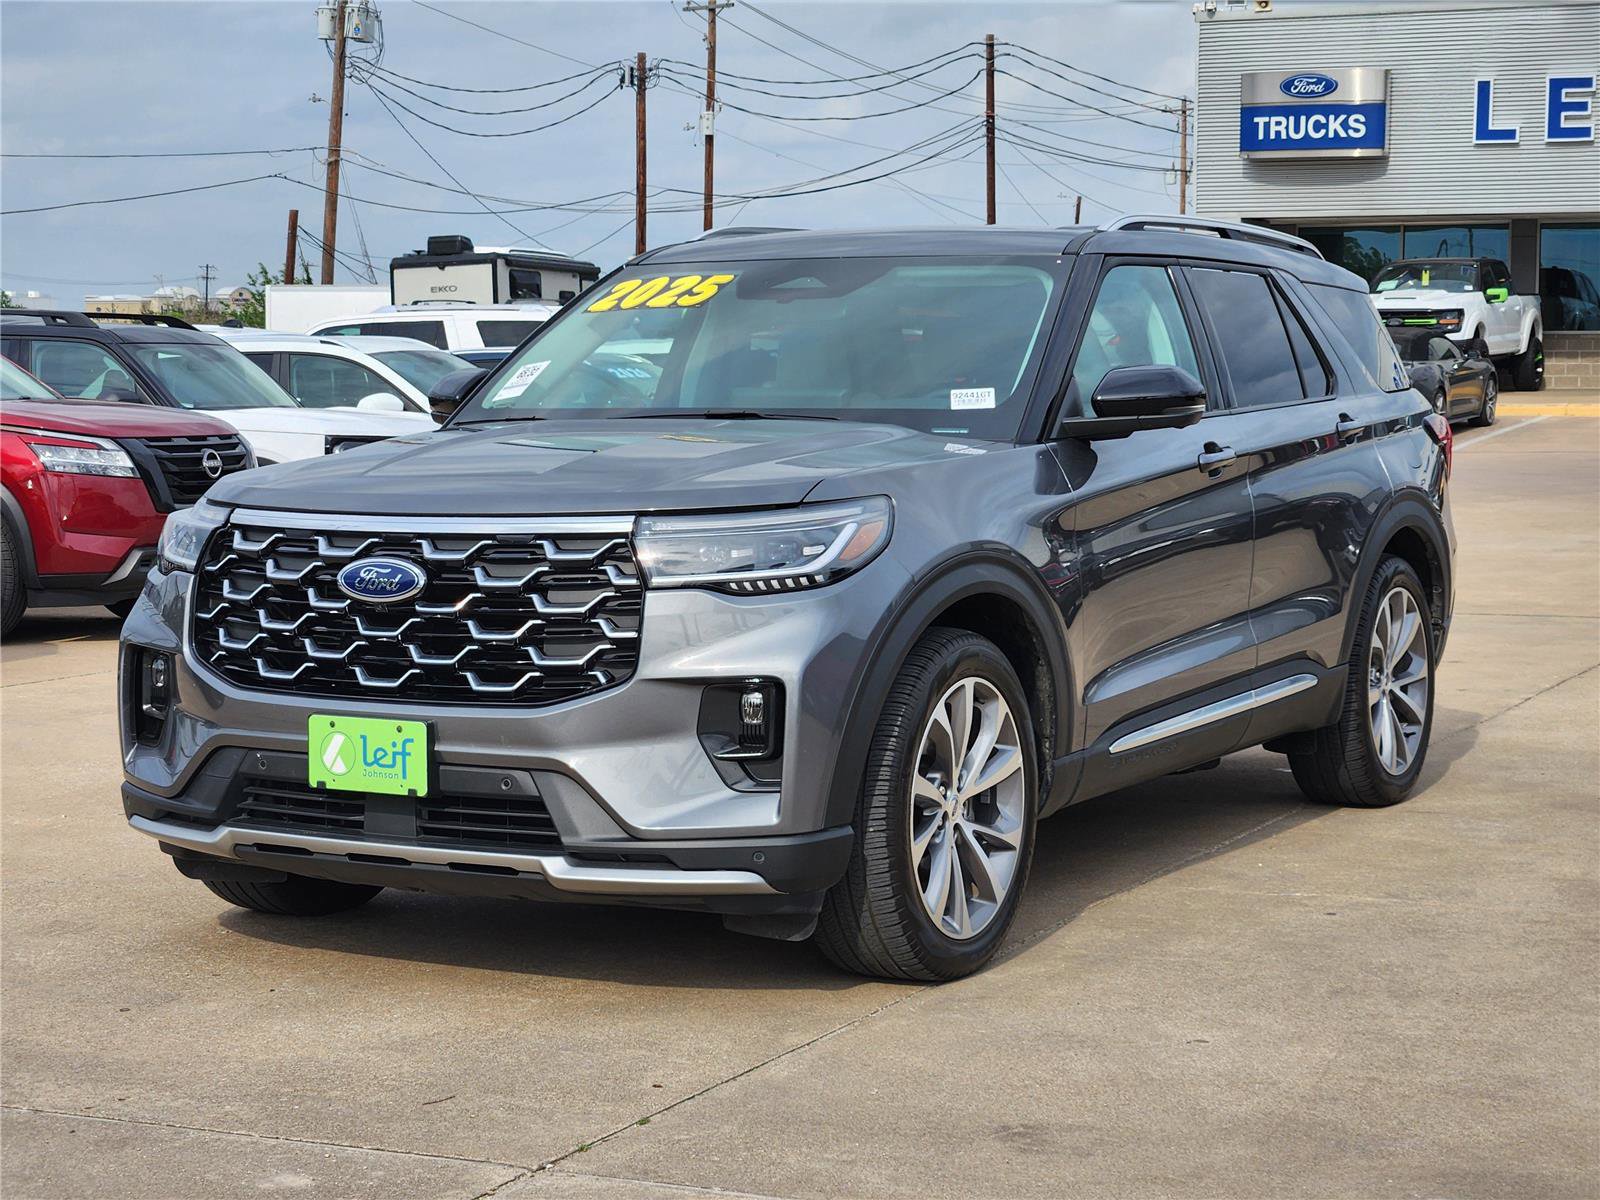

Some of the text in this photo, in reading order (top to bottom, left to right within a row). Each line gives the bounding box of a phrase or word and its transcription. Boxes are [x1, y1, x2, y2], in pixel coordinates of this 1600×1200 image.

[1290, 77, 1326, 94] Ford
[1253, 113, 1367, 140] TRUCKS
[586, 274, 735, 313] 2025
[354, 566, 403, 592] Ford
[360, 734, 415, 780] leif
[362, 769, 399, 780] Johnson
